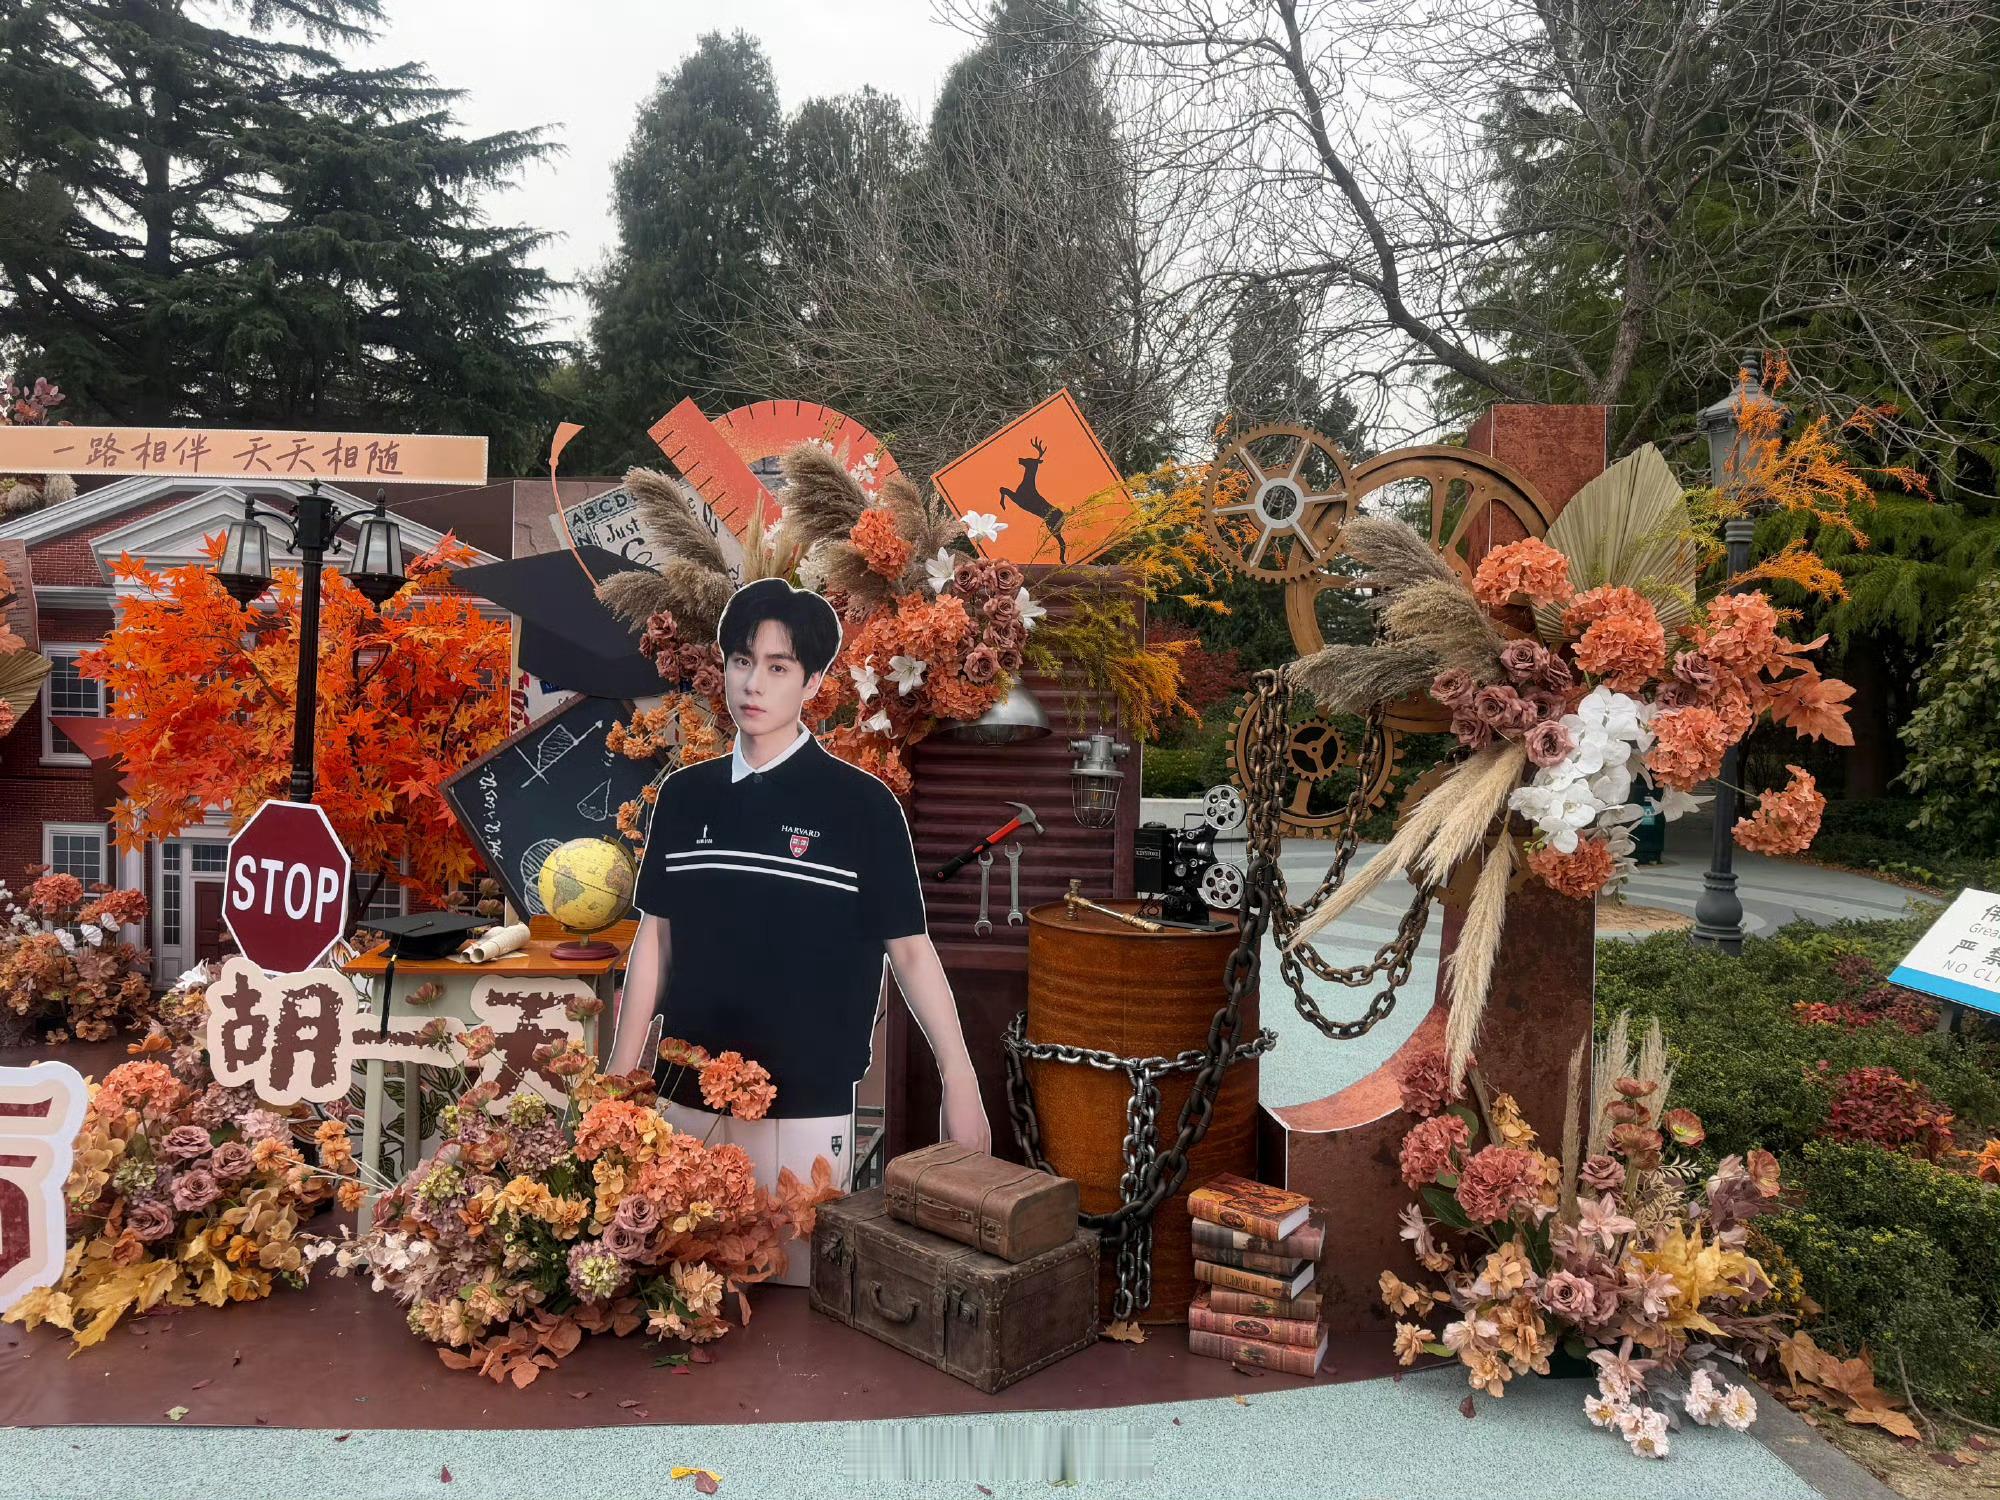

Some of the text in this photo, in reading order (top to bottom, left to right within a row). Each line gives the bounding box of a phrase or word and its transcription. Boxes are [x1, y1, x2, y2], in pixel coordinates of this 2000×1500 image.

[52, 432, 404, 475] 一路相伴 天天相随
[607, 517, 640, 543] Just
[781, 824, 821, 838] HARVARD
[231, 854, 340, 924] STOP
[1968, 922, 2000, 939] Grea
[1942, 959, 1968, 974] NO
[221, 971, 576, 1100] 胡一天
